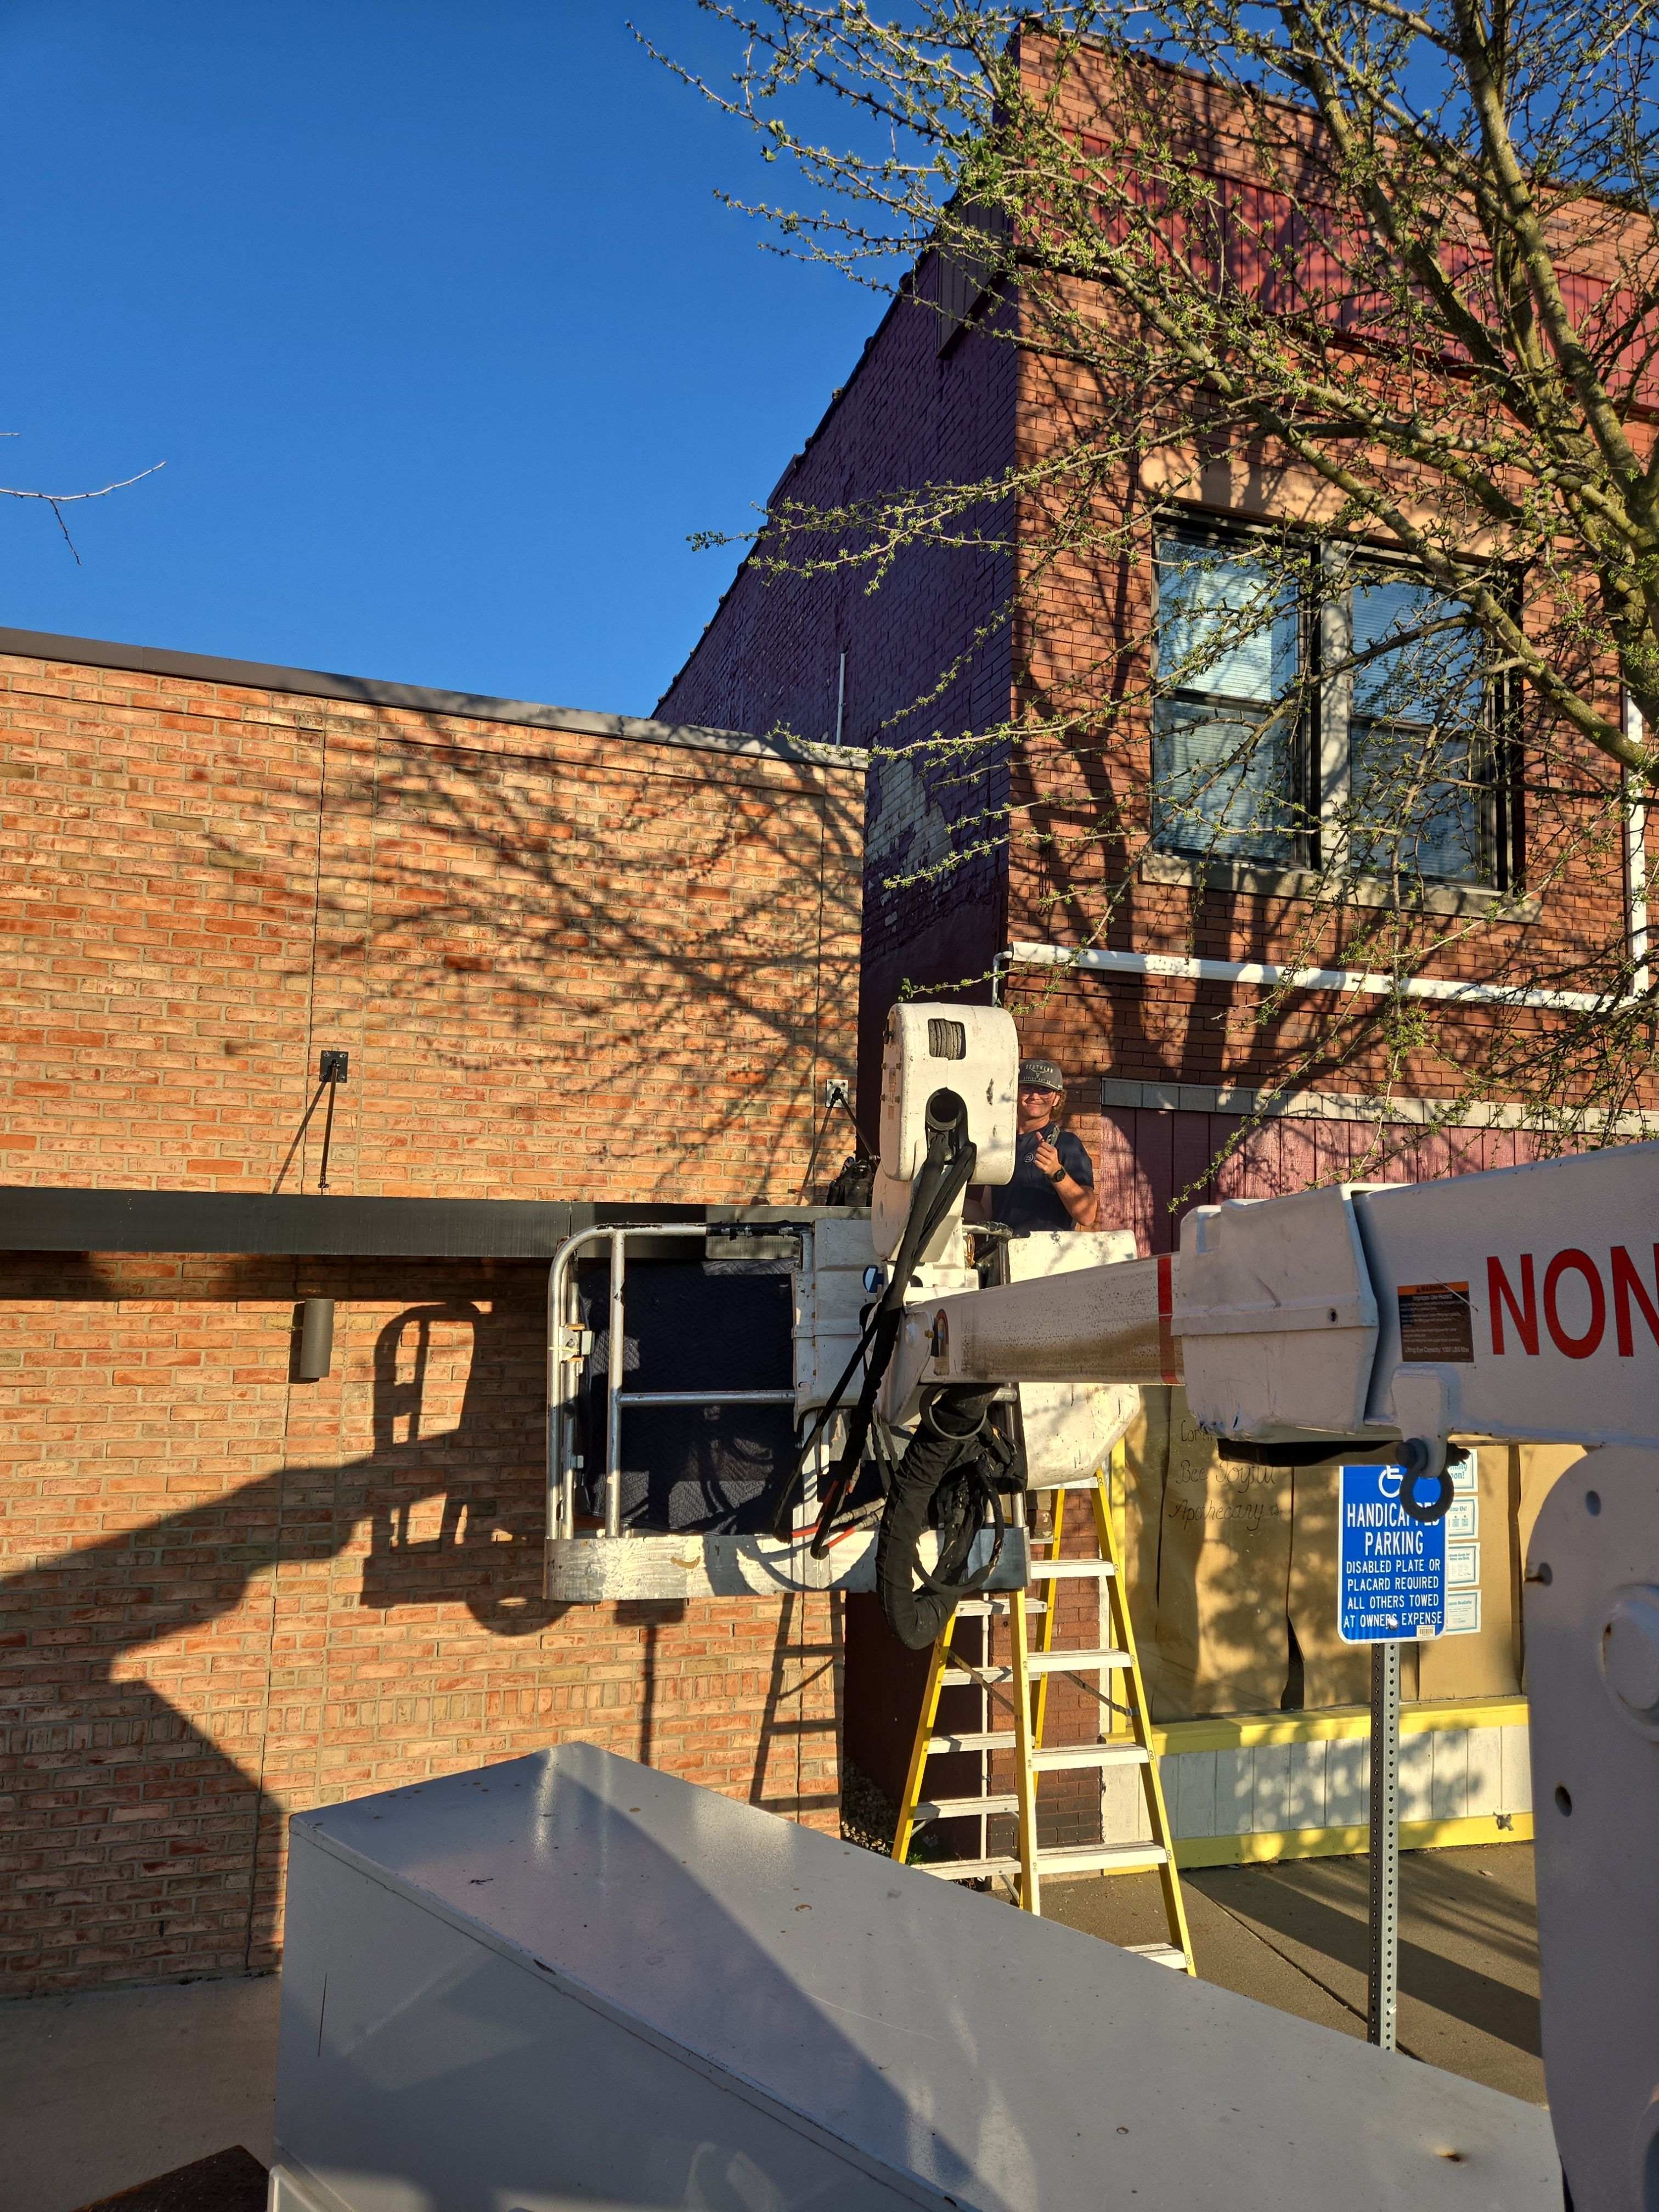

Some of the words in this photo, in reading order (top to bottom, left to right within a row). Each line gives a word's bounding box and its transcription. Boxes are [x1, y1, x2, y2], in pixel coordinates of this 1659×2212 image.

[1026, 1064, 1053, 1074] SOUTHERN
[1176, 1460, 1208, 1483] Bee
[1169, 1499, 1264, 1531] Apothecary
[1347, 1503, 1440, 1527] HANDICA
[1365, 1531, 1424, 1556] PARKING
[1346, 1560, 1391, 1573] DISABLED
[1396, 1559, 1424, 1572] PLATE
[1429, 1559, 1441, 1571] OR
[1347, 1578, 1390, 1592] PLACARD
[1395, 1576, 1439, 1590] REQUIRED
[1347, 1597, 1365, 1610] ALL
[1370, 1595, 1404, 1609] OTHERS
[1409, 1594, 1439, 1607] TOWED
[1344, 1616, 1355, 1628] AT
[1402, 1611, 1442, 1626] EXPENSE
